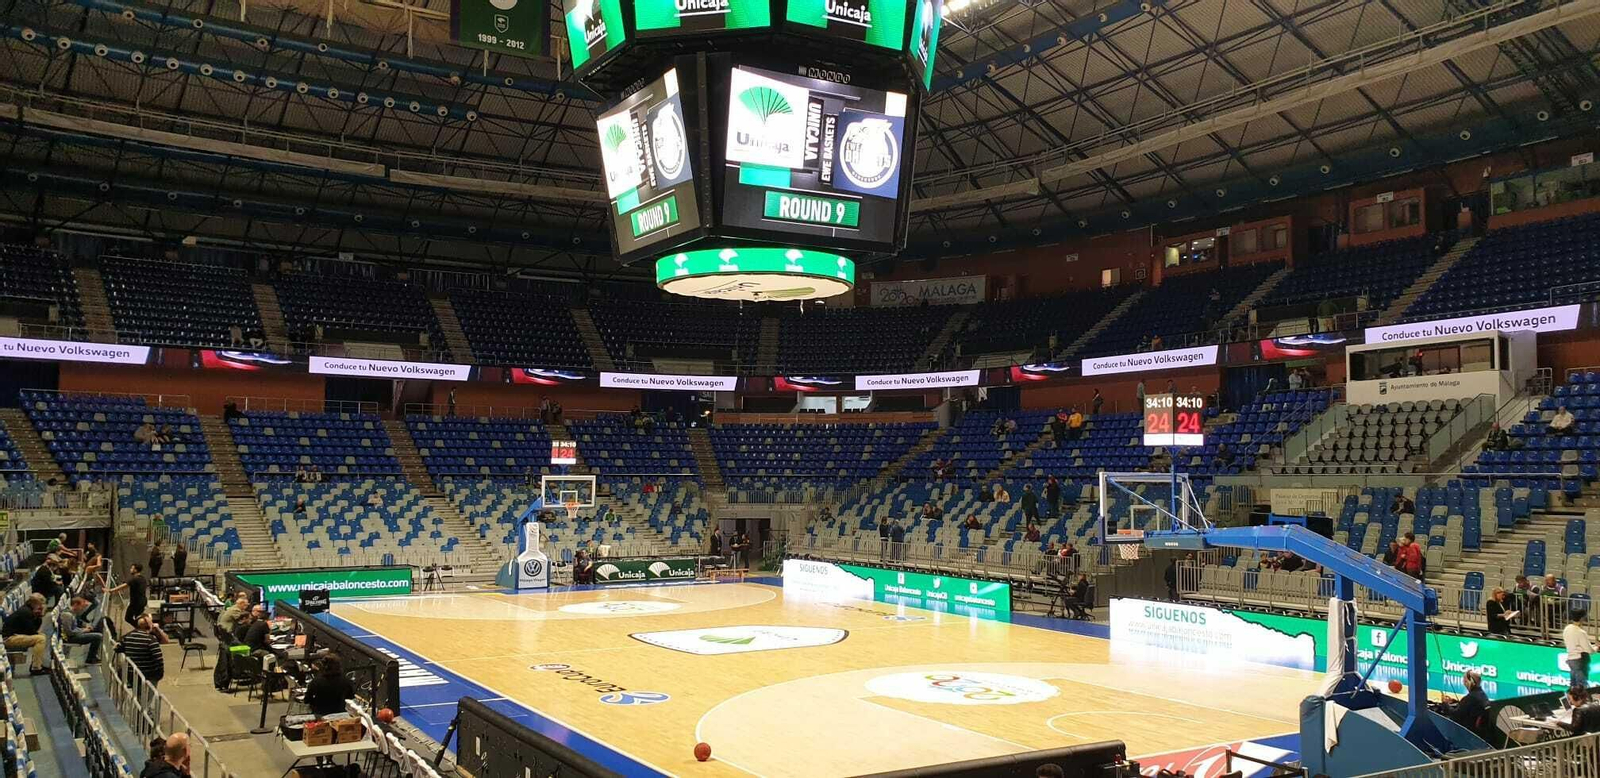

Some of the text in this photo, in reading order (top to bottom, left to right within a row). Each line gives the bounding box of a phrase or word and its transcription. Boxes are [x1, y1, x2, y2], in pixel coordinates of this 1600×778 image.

[824, 0, 872, 21] Unicaja
[584, 19, 606, 44] Unicaja
[478, 33, 497, 44] 1999
[506, 39, 525, 49] 2012
[808, 67, 850, 83] MONDO
[804, 102, 822, 161] UNICAJA
[821, 116, 836, 182] EWE BASKETS
[637, 202, 671, 233] ROUND 9
[780, 196, 845, 223] ROUND 9
[1382, 313, 1556, 341] Conduce tu Nuevo Volkswagen
[4, 342, 130, 359] tu Nuevo Volkswagen
[324, 361, 357, 371] Conduce
[368, 363, 398, 373] Nuevo
[400, 364, 456, 377] Volkswagen
[1093, 352, 1204, 370] Conduce tu Nuevo Volkswagen
[612, 376, 640, 385] Conduce
[649, 377, 675, 387] Nuevo
[676, 378, 724, 389] Volkswagen
[866, 378, 893, 386] Conduce
[901, 376, 925, 385] Nuevo
[926, 374, 969, 386] Volkswagen
[1147, 397, 1173, 408] 34:10
[1176, 397, 1203, 409] 34:10
[1147, 412, 1170, 433] 24
[1177, 412, 1200, 433] 24
[618, 570, 646, 580] Unicaja
[669, 568, 695, 577] Unicaja
[1357, 648, 1373, 660] caja
[1442, 658, 1497, 677] UnicajaCB
